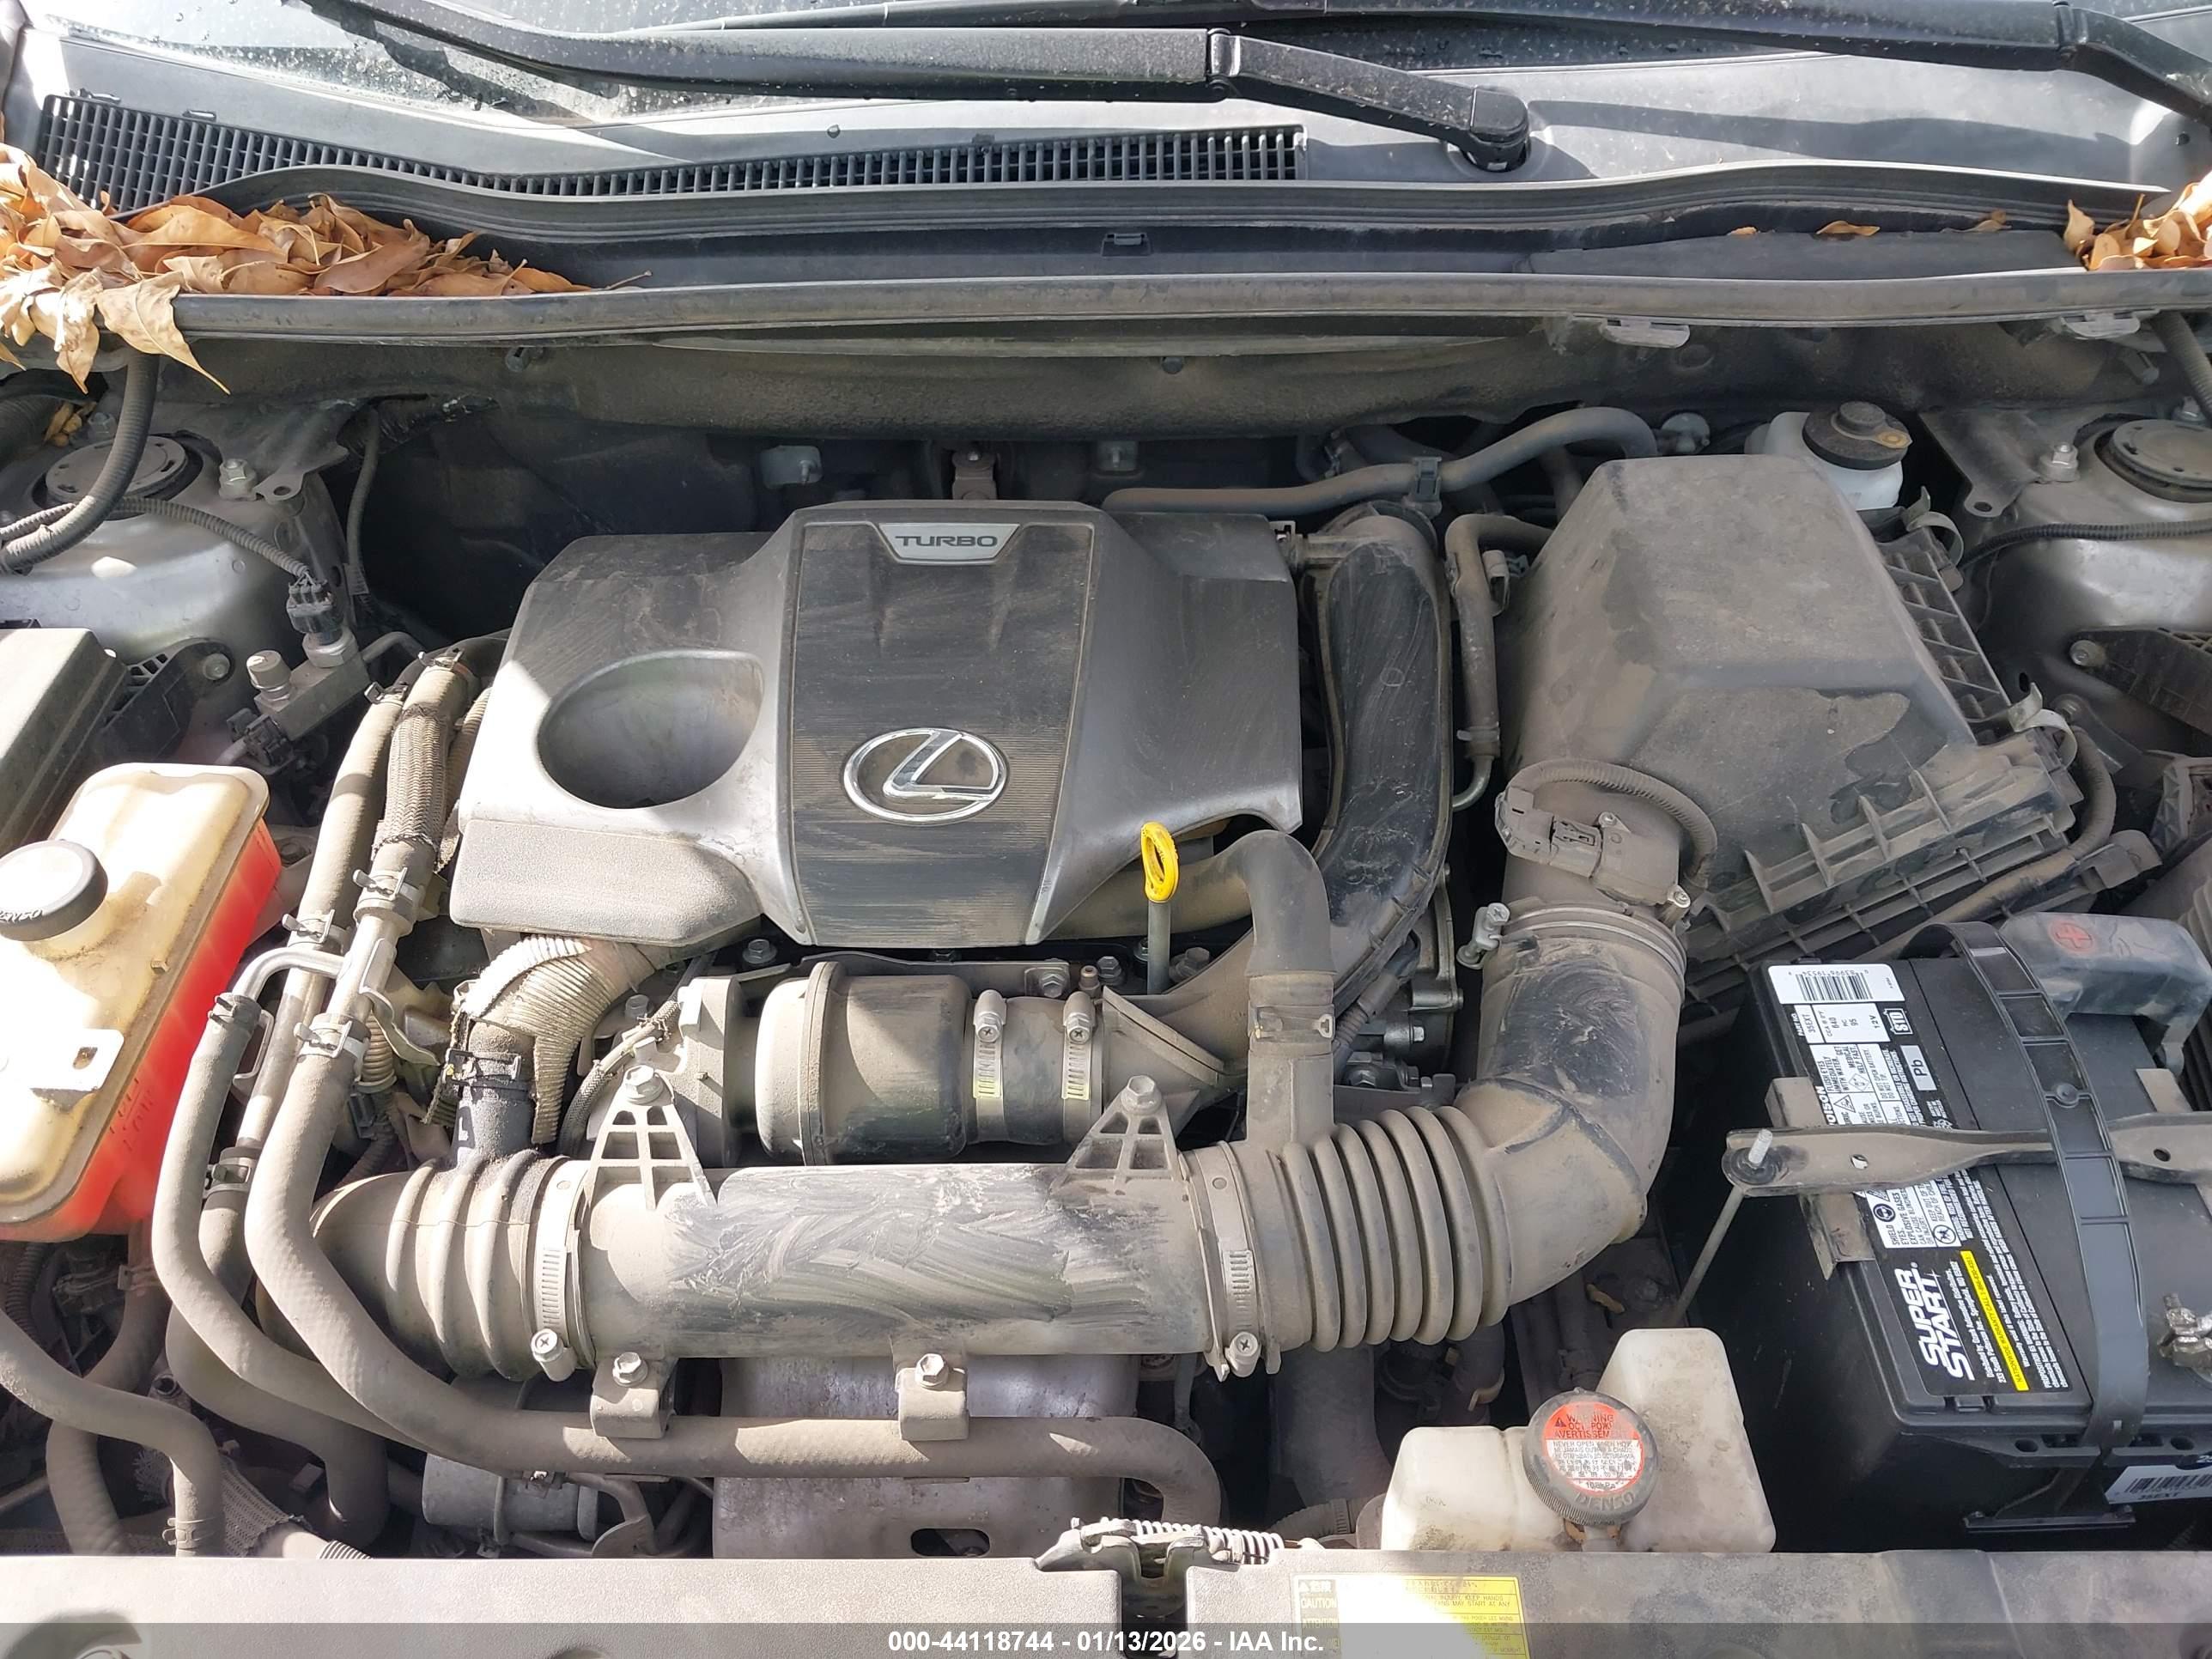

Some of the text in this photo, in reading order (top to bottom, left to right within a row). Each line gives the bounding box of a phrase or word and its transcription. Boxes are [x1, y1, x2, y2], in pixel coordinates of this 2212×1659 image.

[895, 536, 997, 548] TURBO
[1794, 1022, 1804, 1036] PART
[1802, 1013, 1815, 1032] 35EXT
[1828, 1017, 1839, 1028] 640
[1848, 1018, 1858, 1026] 95
[1869, 1014, 1880, 1028] 12V
[1889, 1012, 1908, 1030] STD
[1842, 1046, 1856, 1068] MEDICAL
[1823, 1056, 1841, 1092] IMMEDIATELY
[1854, 1060, 1865, 1073] HELP
[1911, 1059, 1927, 1076] Pb
[1816, 1060, 1834, 1091] FLUSH EYES
[1838, 1077, 1849, 1091] WITH
[1922, 1198, 1933, 1208] OUT
[1891, 1192, 1918, 1244] EXPLOSIVE GASES
[1927, 1209, 1938, 1222] KEEP
[1933, 1204, 1945, 1221] REACH
[1885, 1224, 1899, 1245] SHIELD
[1982, 1297, 1992, 1311] CALL
[1894, 1268, 1940, 1366] SUPER
[1910, 1267, 1975, 1381] START
[1989, 1312, 2006, 1344] WARRANTY
[2002, 1345, 2021, 1382] NATIONWIDE
[1302, 1597, 1337, 1608] CAUTION
